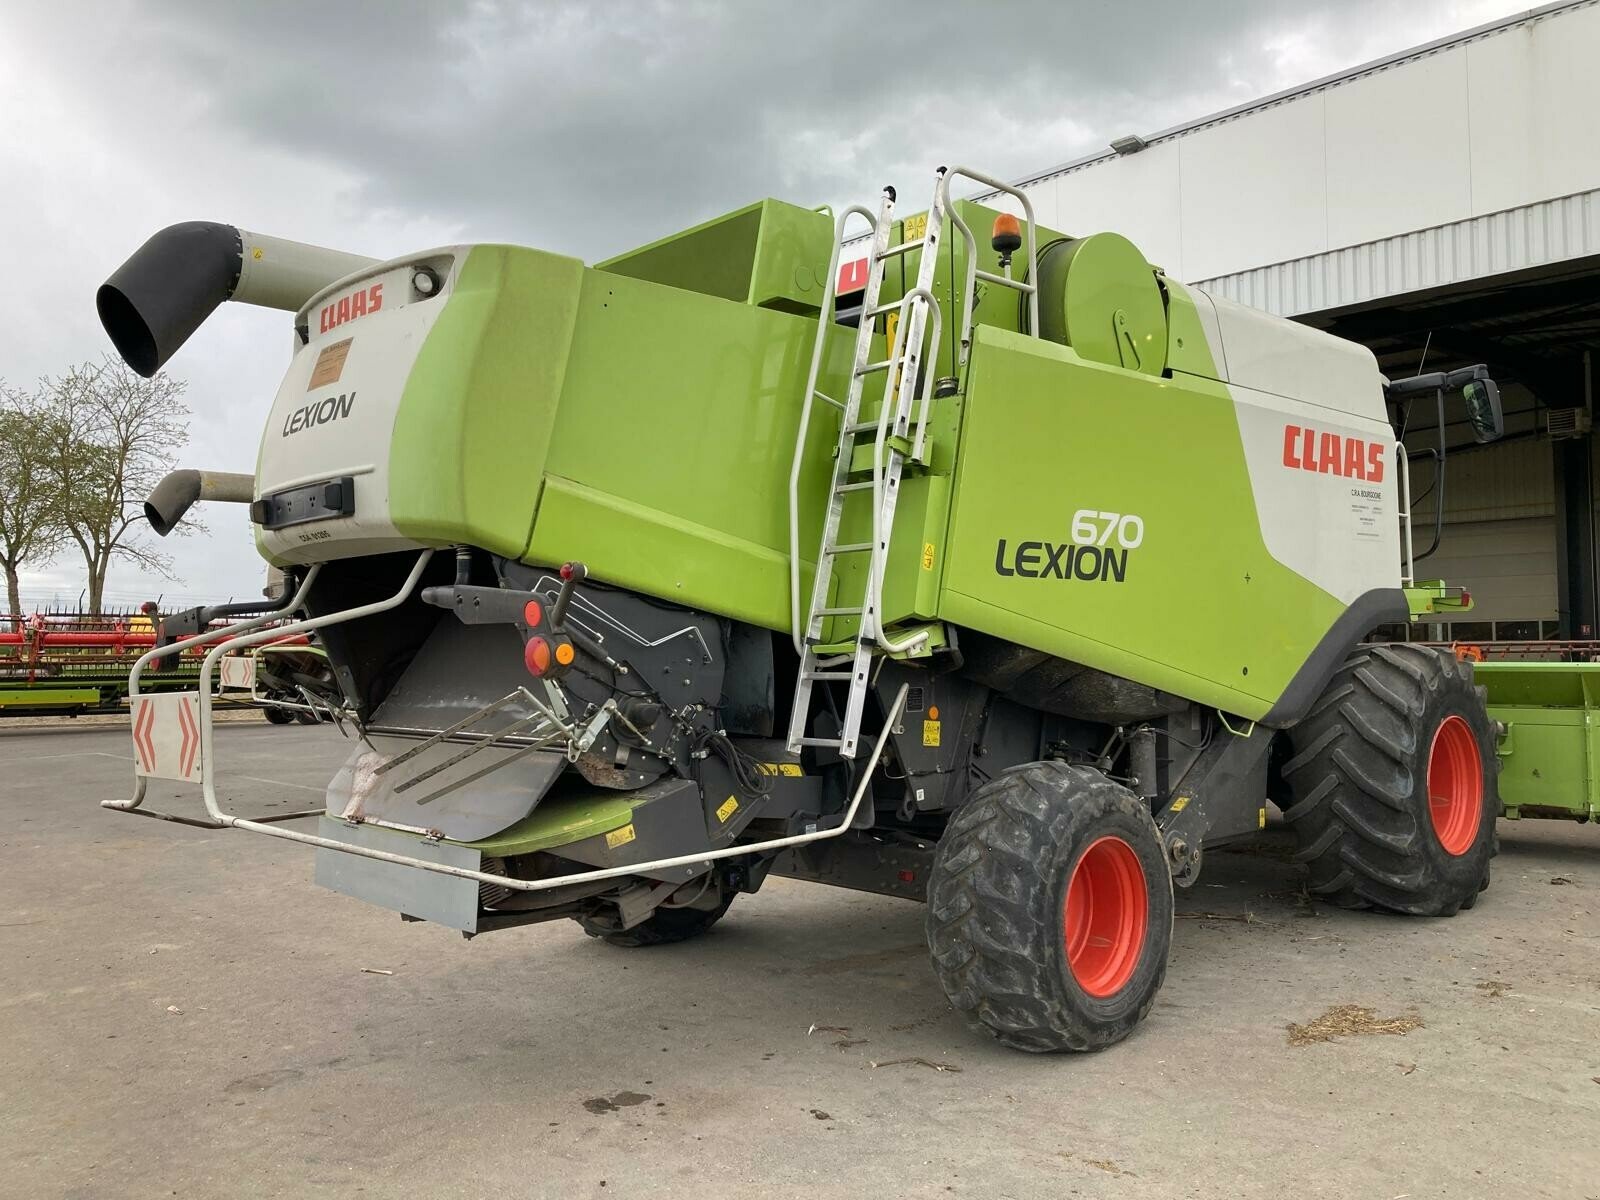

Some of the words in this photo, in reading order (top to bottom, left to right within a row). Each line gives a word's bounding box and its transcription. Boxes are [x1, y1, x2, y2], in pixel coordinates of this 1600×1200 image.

[319, 283, 384, 334] CLAAS
[282, 391, 356, 438] LEXION
[1283, 424, 1385, 483] CLAAS
[1071, 509, 1144, 549] 670
[995, 538, 1128, 583] LEXION
